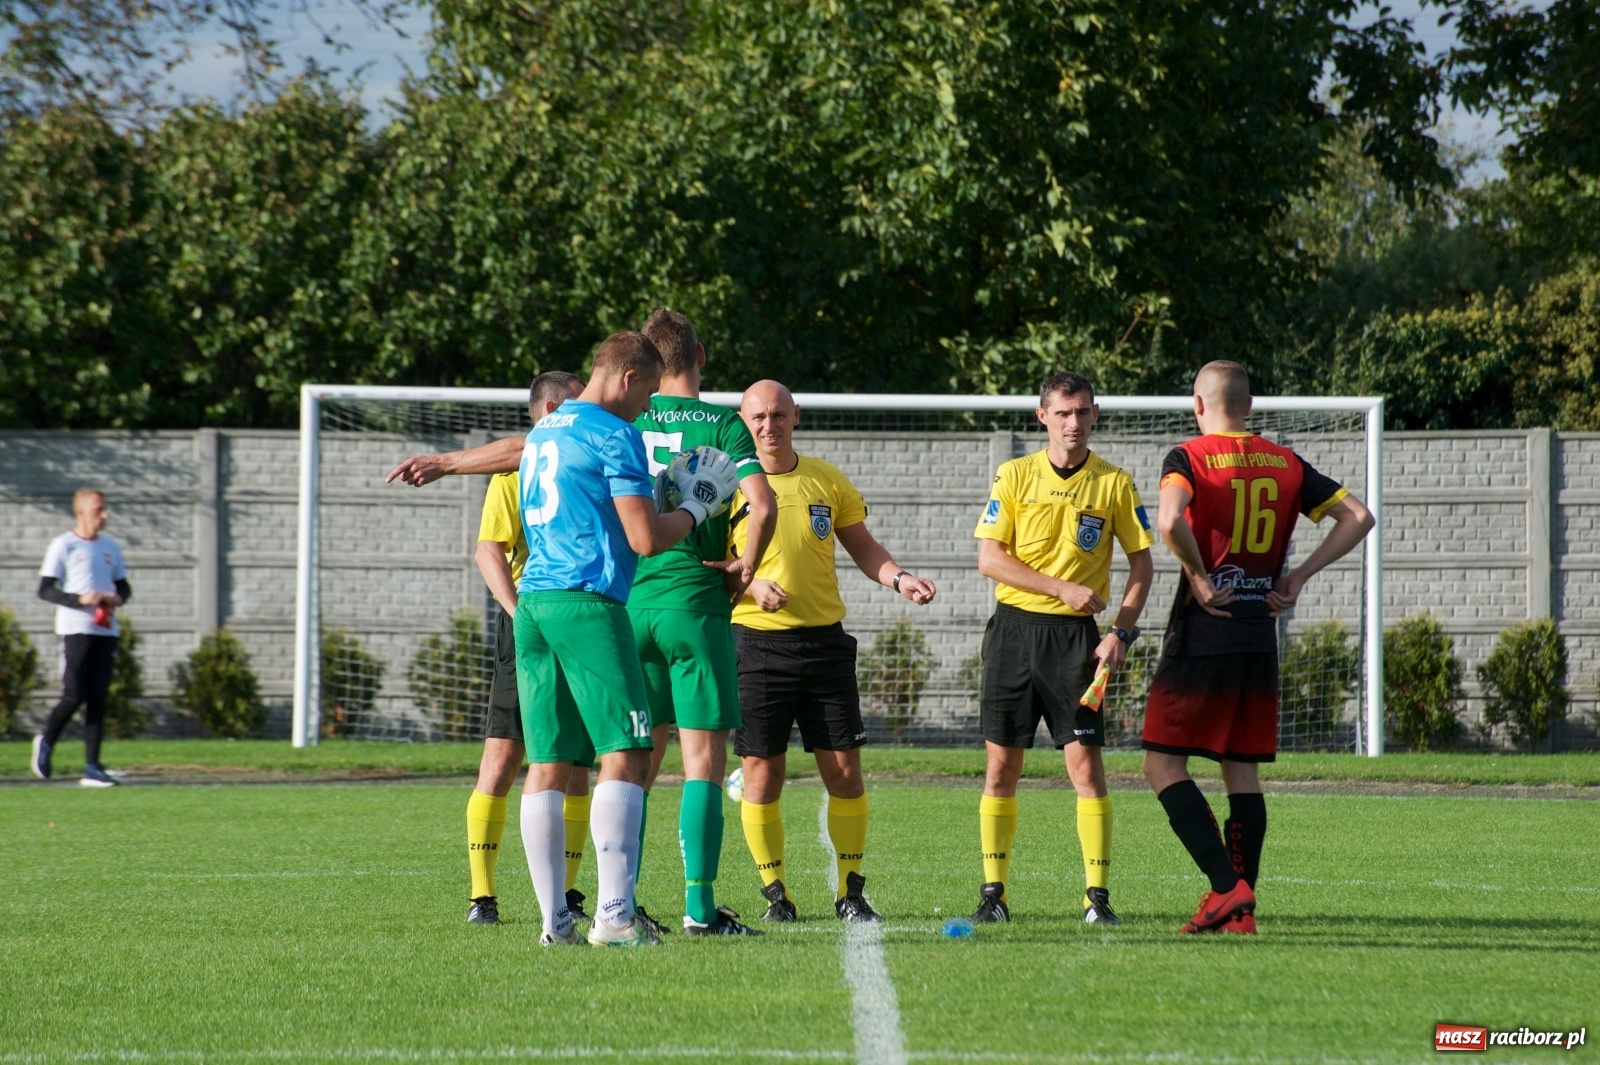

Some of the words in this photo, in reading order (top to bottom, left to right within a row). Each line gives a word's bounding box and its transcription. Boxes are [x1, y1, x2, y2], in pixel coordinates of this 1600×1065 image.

[519, 440, 560, 527] 23
[1229, 477, 1279, 554] 16
[629, 710, 650, 738] 12
[470, 843, 498, 851] zina
[565, 850, 583, 860] zin
